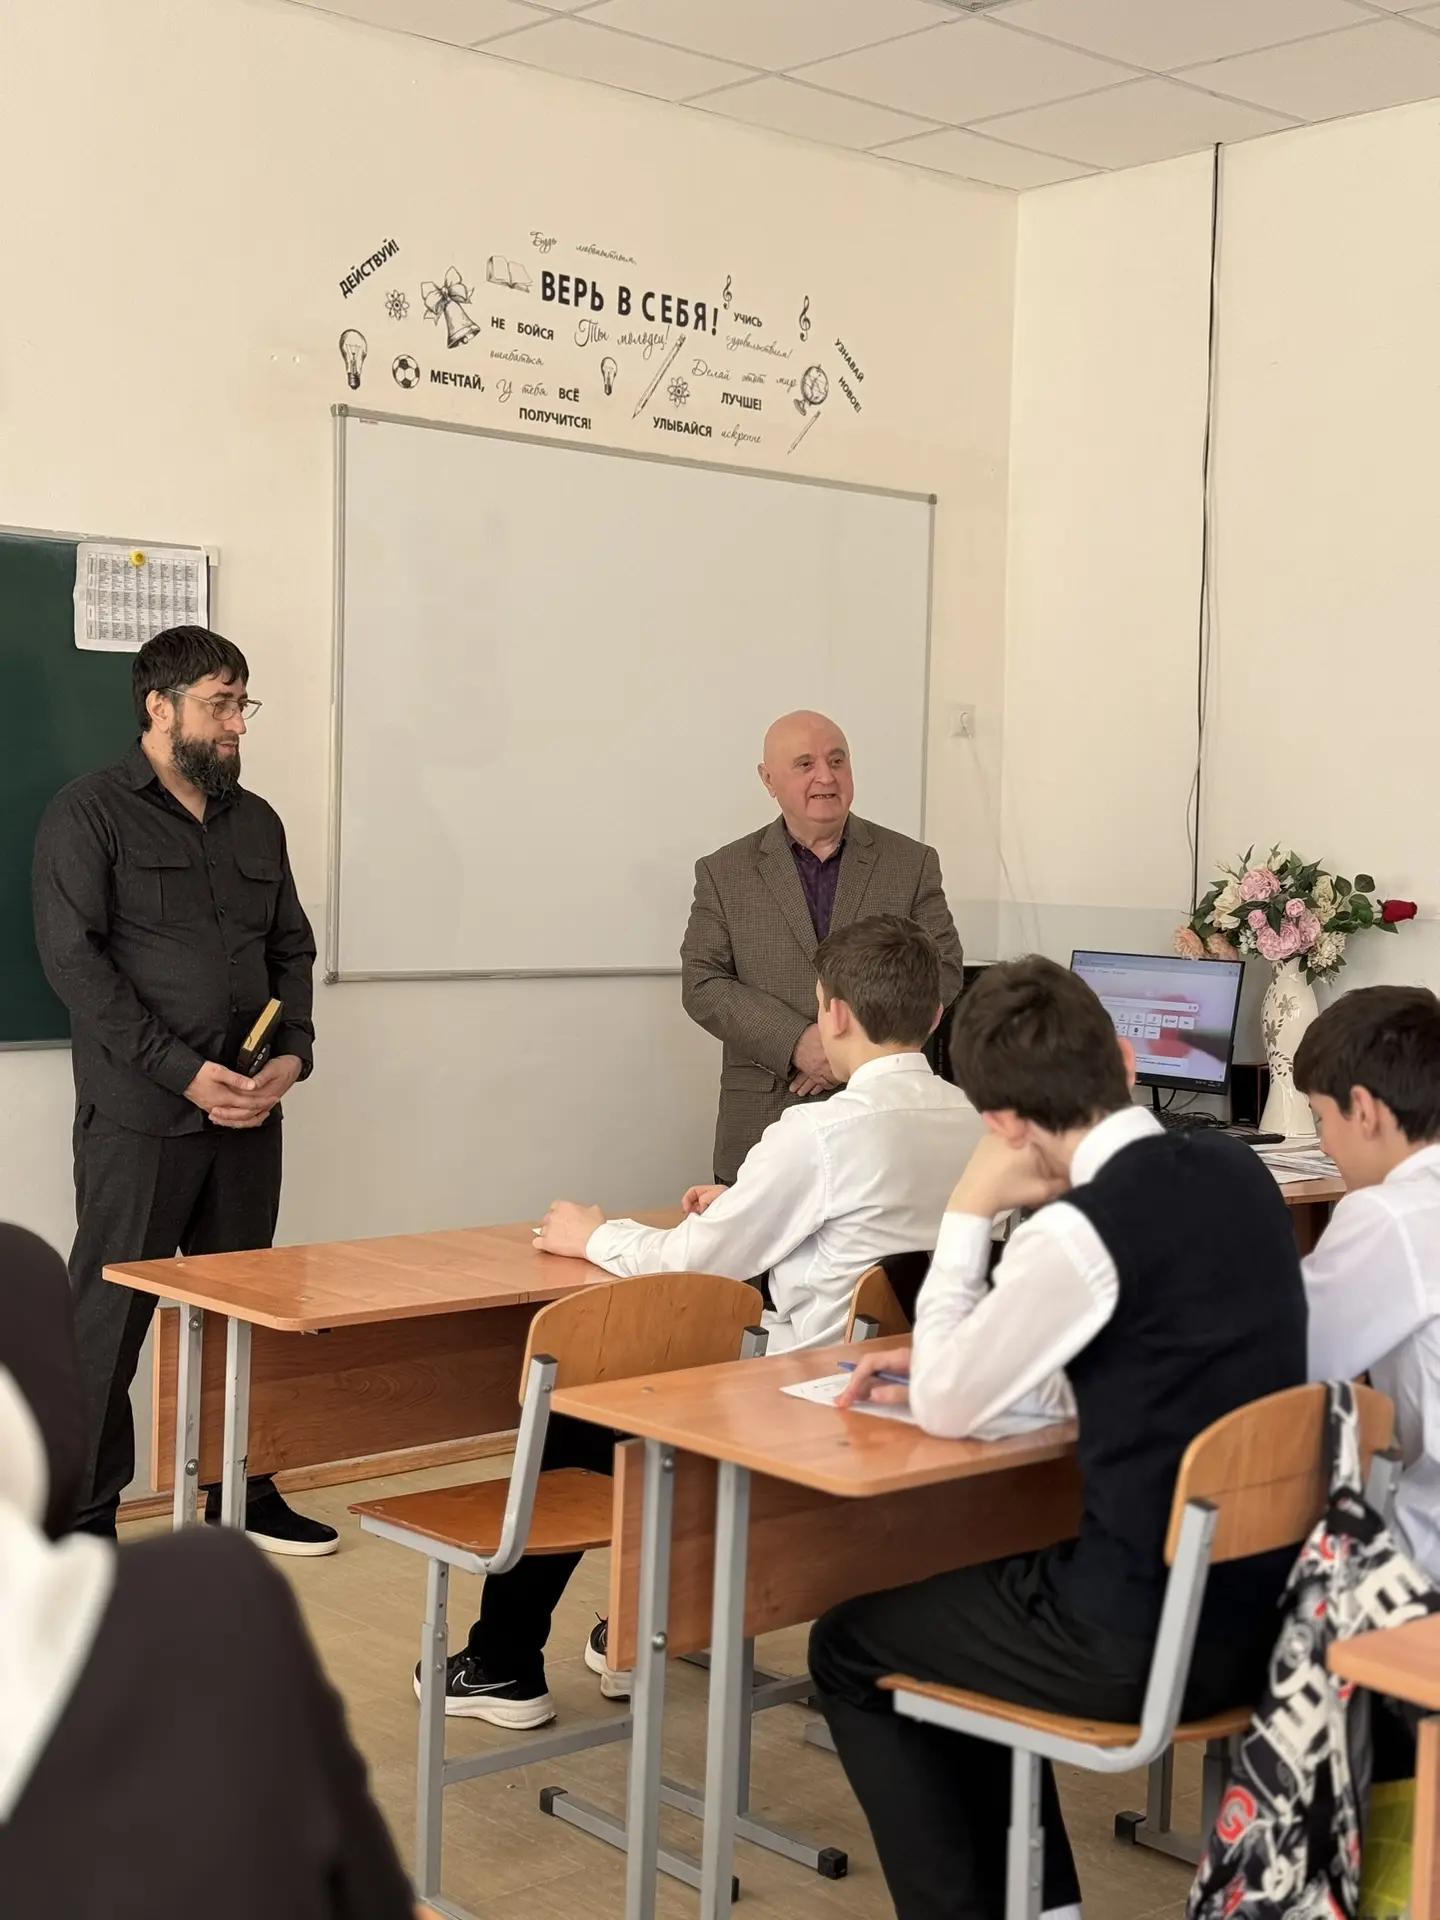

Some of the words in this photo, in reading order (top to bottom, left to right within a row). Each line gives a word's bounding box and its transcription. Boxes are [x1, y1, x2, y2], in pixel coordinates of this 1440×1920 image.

[530, 231, 557, 253] Будь
[338, 239, 400, 299] ДЕЙСТВУЙ!
[542, 271, 604, 312] ВЕРЬ
[618, 286, 631, 316] В
[640, 291, 718, 337] СЕБЯ!
[734, 312, 762, 327] УЧИСЬ
[491, 316, 505, 330] НЕ
[517, 322, 554, 340] БОЙСЯ
[574, 319, 609, 347] Ты
[617, 325, 671, 361] молодец!
[691, 358, 732, 381] Делай
[741, 372, 767, 384] этот
[776, 378, 796, 393] мир
[835, 338, 864, 384] УЗНАВАЙ
[430, 369, 485, 392] МЕЧТАЙ,
[496, 379, 513, 403] У
[522, 383, 548, 396] тебя
[559, 387, 579, 402] ВСЁ
[721, 392, 761, 411] ЛУЧШЕ!
[839, 375, 863, 413] НОВОЕ!
[519, 407, 591, 430] ПОЛУЧИТСЯ!
[653, 416, 712, 438] УЛЫБАЙСЯ
[721, 424, 760, 446] искренне
